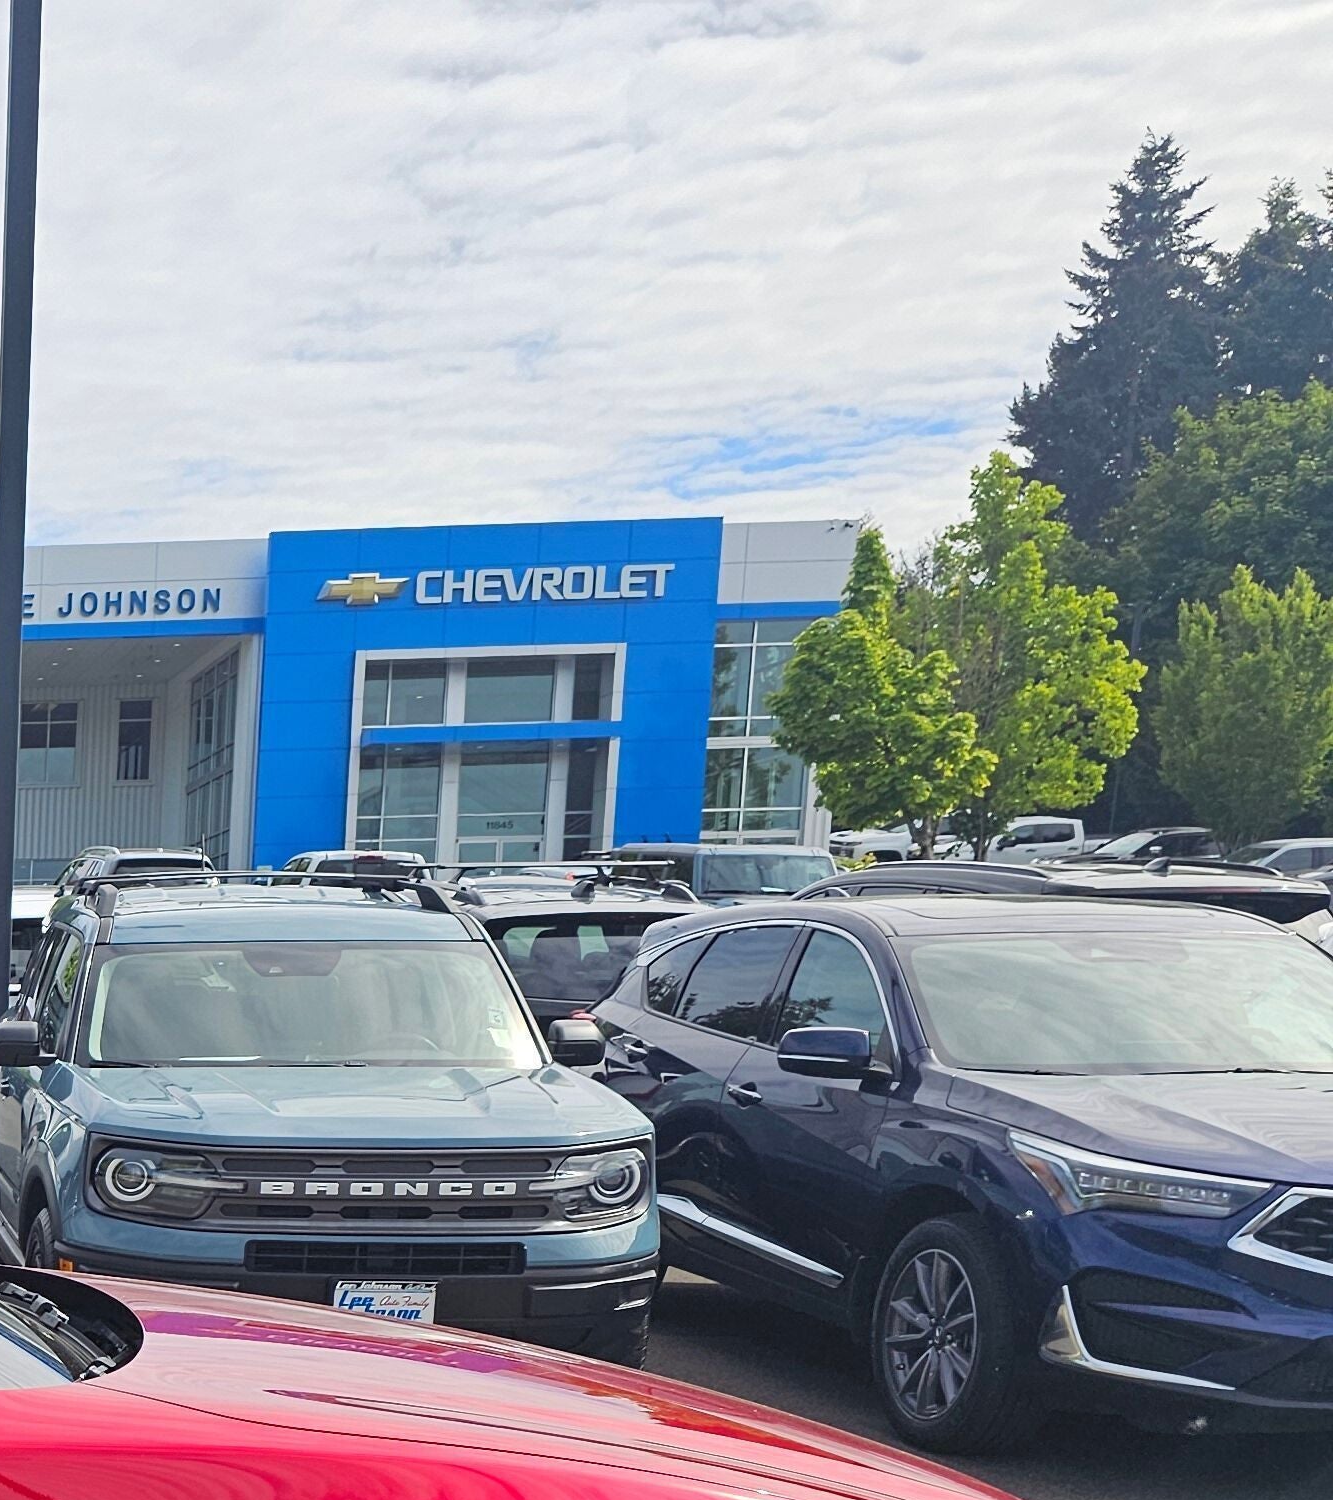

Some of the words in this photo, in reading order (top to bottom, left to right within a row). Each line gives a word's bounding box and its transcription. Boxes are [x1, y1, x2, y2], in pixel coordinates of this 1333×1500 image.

[415, 564, 676, 604] CHEVROLET
[57, 588, 221, 618] JOHNSON
[486, 821, 514, 830] 11845
[260, 1181, 517, 1196] BRONCO
[339, 1290, 375, 1308] Lee
[380, 1295, 400, 1306] Auto
